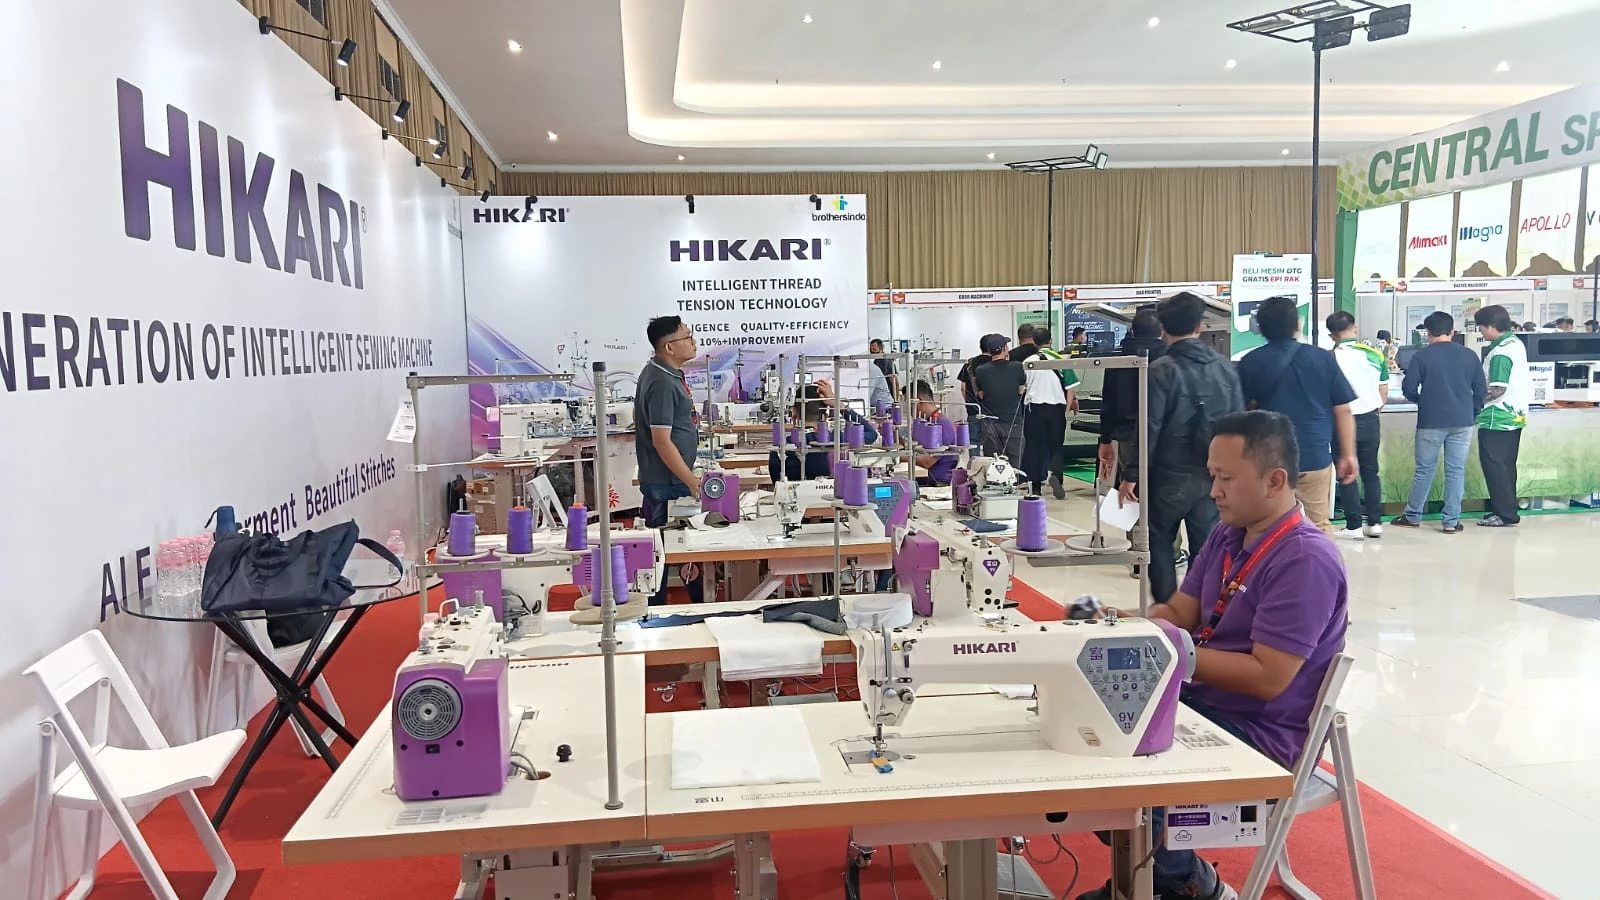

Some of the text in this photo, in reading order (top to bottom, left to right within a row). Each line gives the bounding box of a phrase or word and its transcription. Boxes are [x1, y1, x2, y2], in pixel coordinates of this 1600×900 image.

[1368, 112, 1549, 195] CENTRAL
[117, 78, 364, 290] HIKARI
[811, 212, 866, 222] brothersindo
[1520, 212, 1571, 234] APOLLO
[670, 238, 822, 262] HIKARI
[682, 278, 822, 292] INTELLIGENT THREAD
[1242, 275, 1269, 283] GRATIS
[677, 297, 828, 311] TENSION TECHNOLOGY
[202, 323, 236, 380] OF
[241, 326, 353, 377] INTELLIGENT
[356, 334, 397, 371] SEWING
[397, 336, 433, 369] MACHINE
[304, 464, 360, 521] Beautiful
[360, 453, 396, 494] Stitches
[953, 641, 1017, 655] HIKARI
[1118, 711, 1135, 722] 9V
